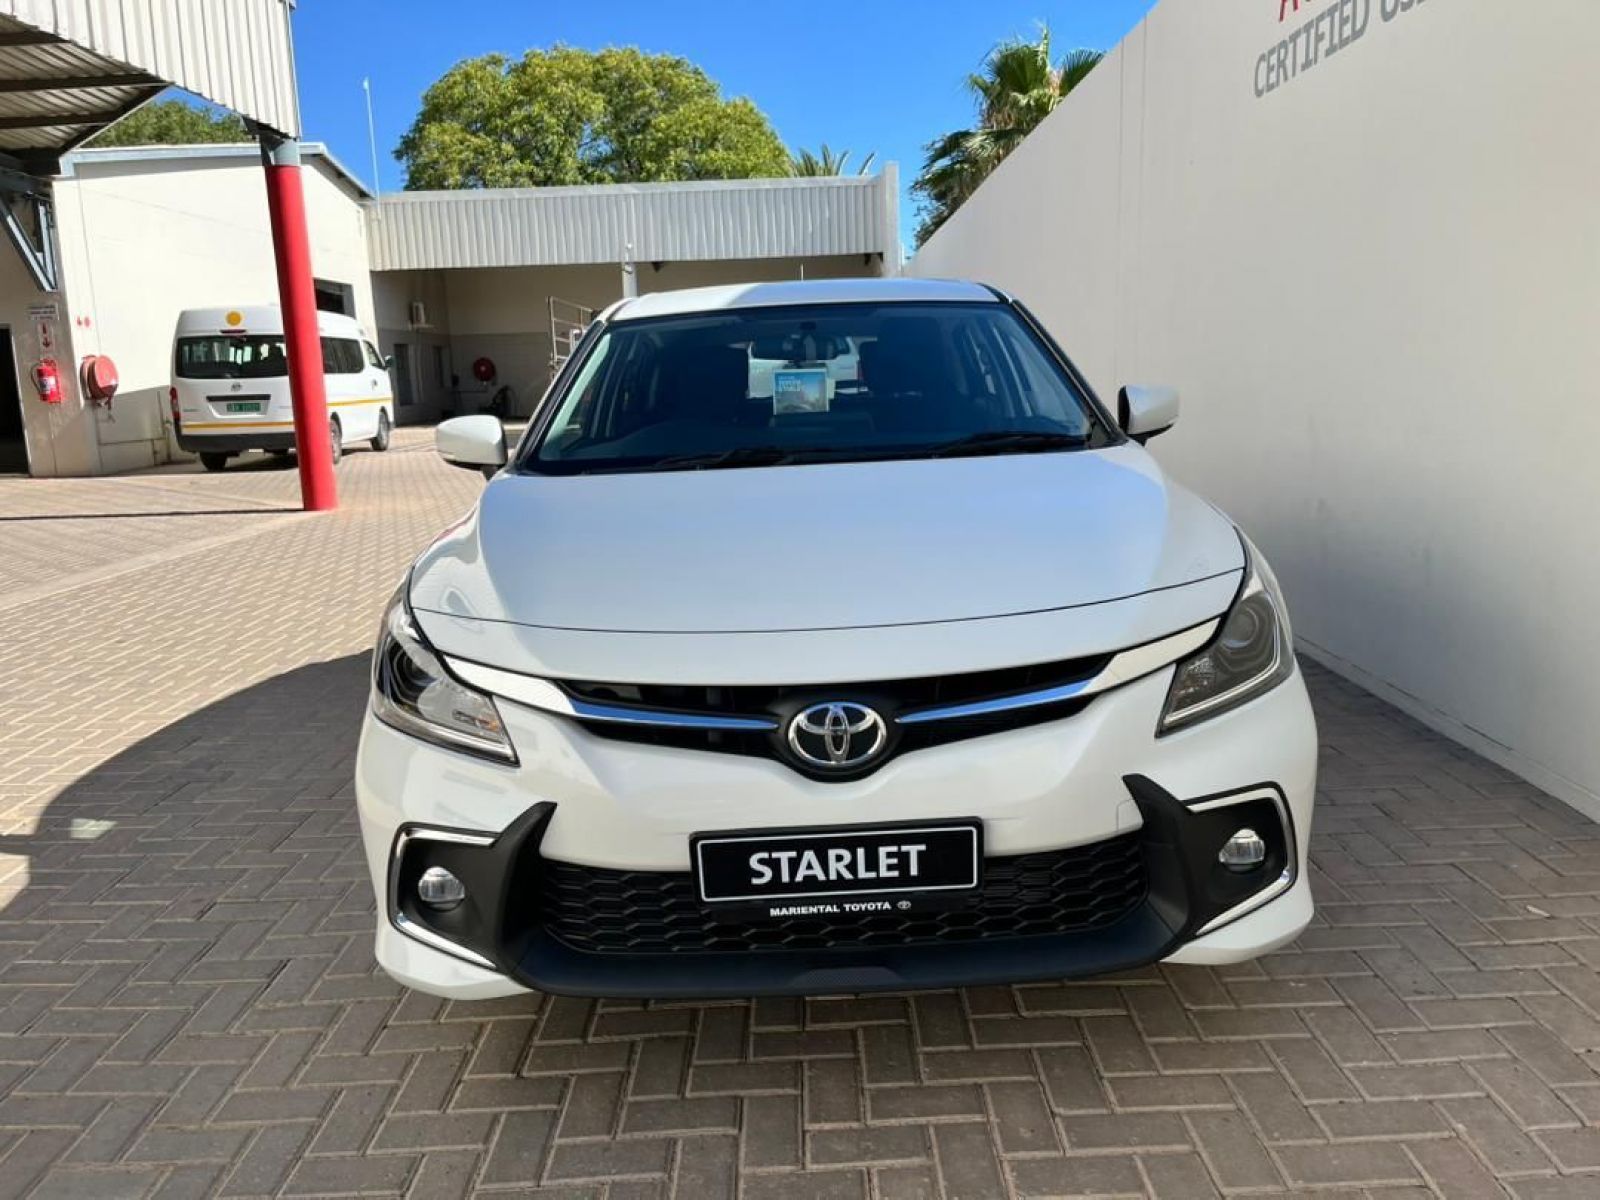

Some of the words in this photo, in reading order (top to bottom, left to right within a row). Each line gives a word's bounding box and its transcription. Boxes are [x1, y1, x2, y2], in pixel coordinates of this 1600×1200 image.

[1254, 0, 1370, 98] CERTIFIED
[749, 844, 926, 885] STARLET
[770, 905, 840, 917] MARIENTAL
[843, 901, 892, 912] TOYOTA
